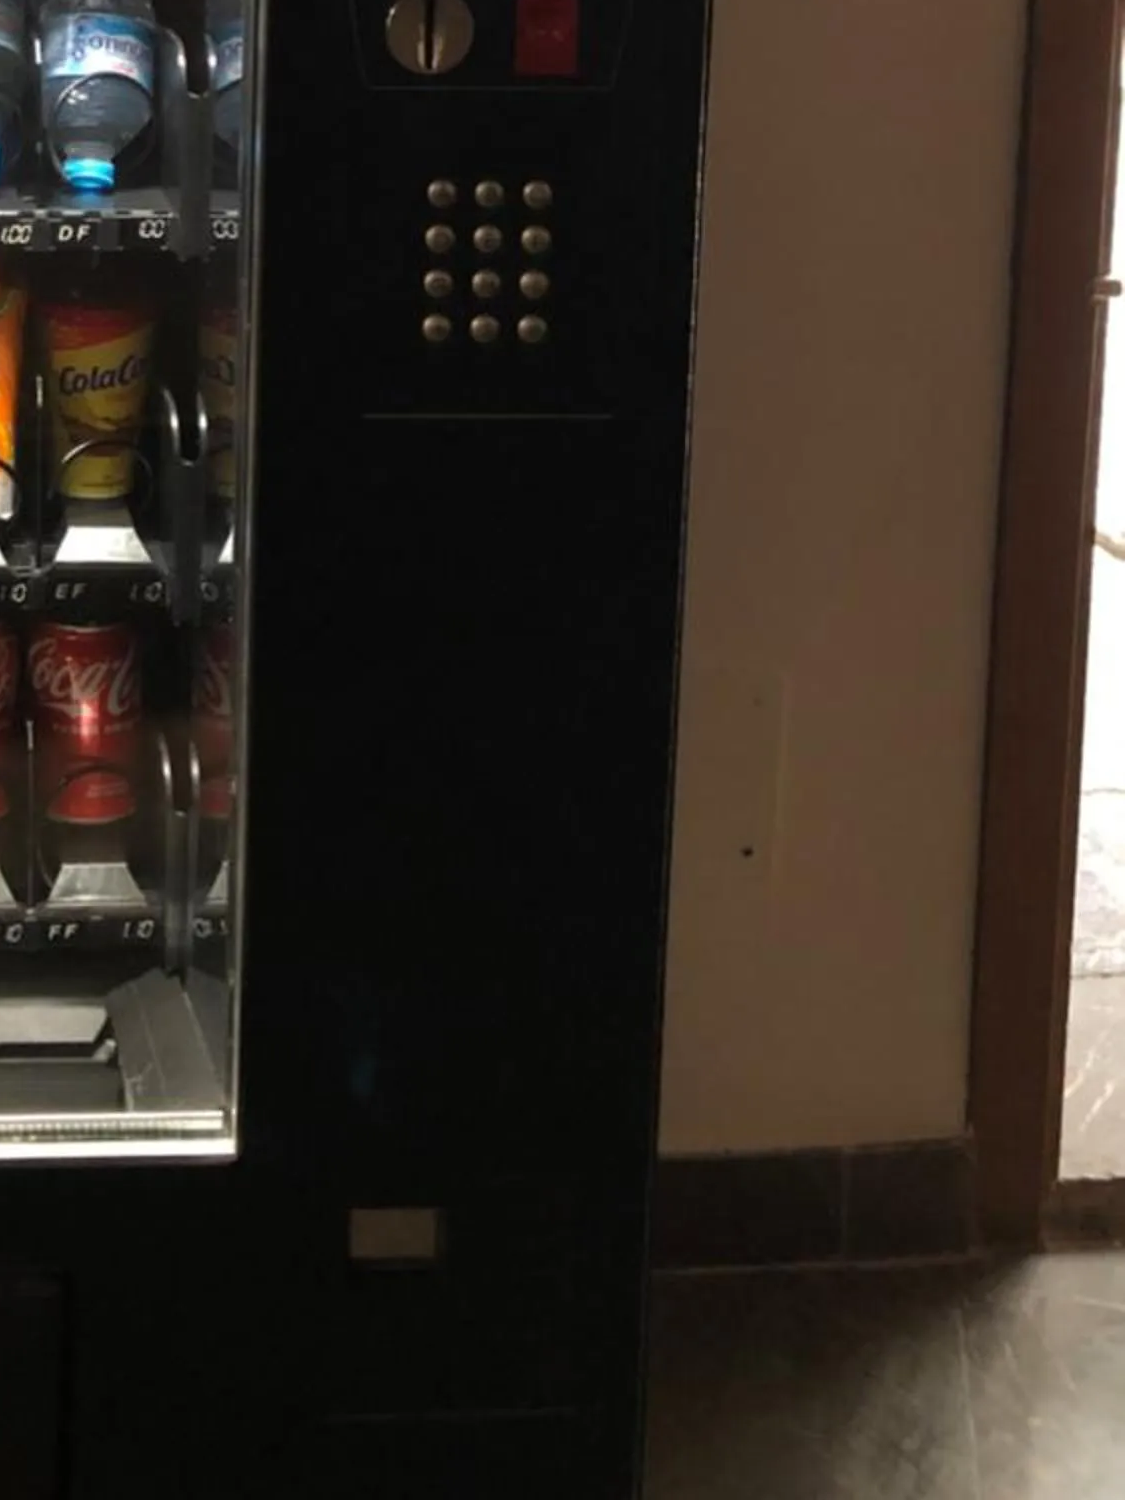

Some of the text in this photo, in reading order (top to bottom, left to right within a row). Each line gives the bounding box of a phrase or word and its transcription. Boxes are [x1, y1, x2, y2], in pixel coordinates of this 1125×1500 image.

[58, 224, 90, 241] DF
[59, 355, 148, 396] ColaC
[48, 923, 77, 939] FF
